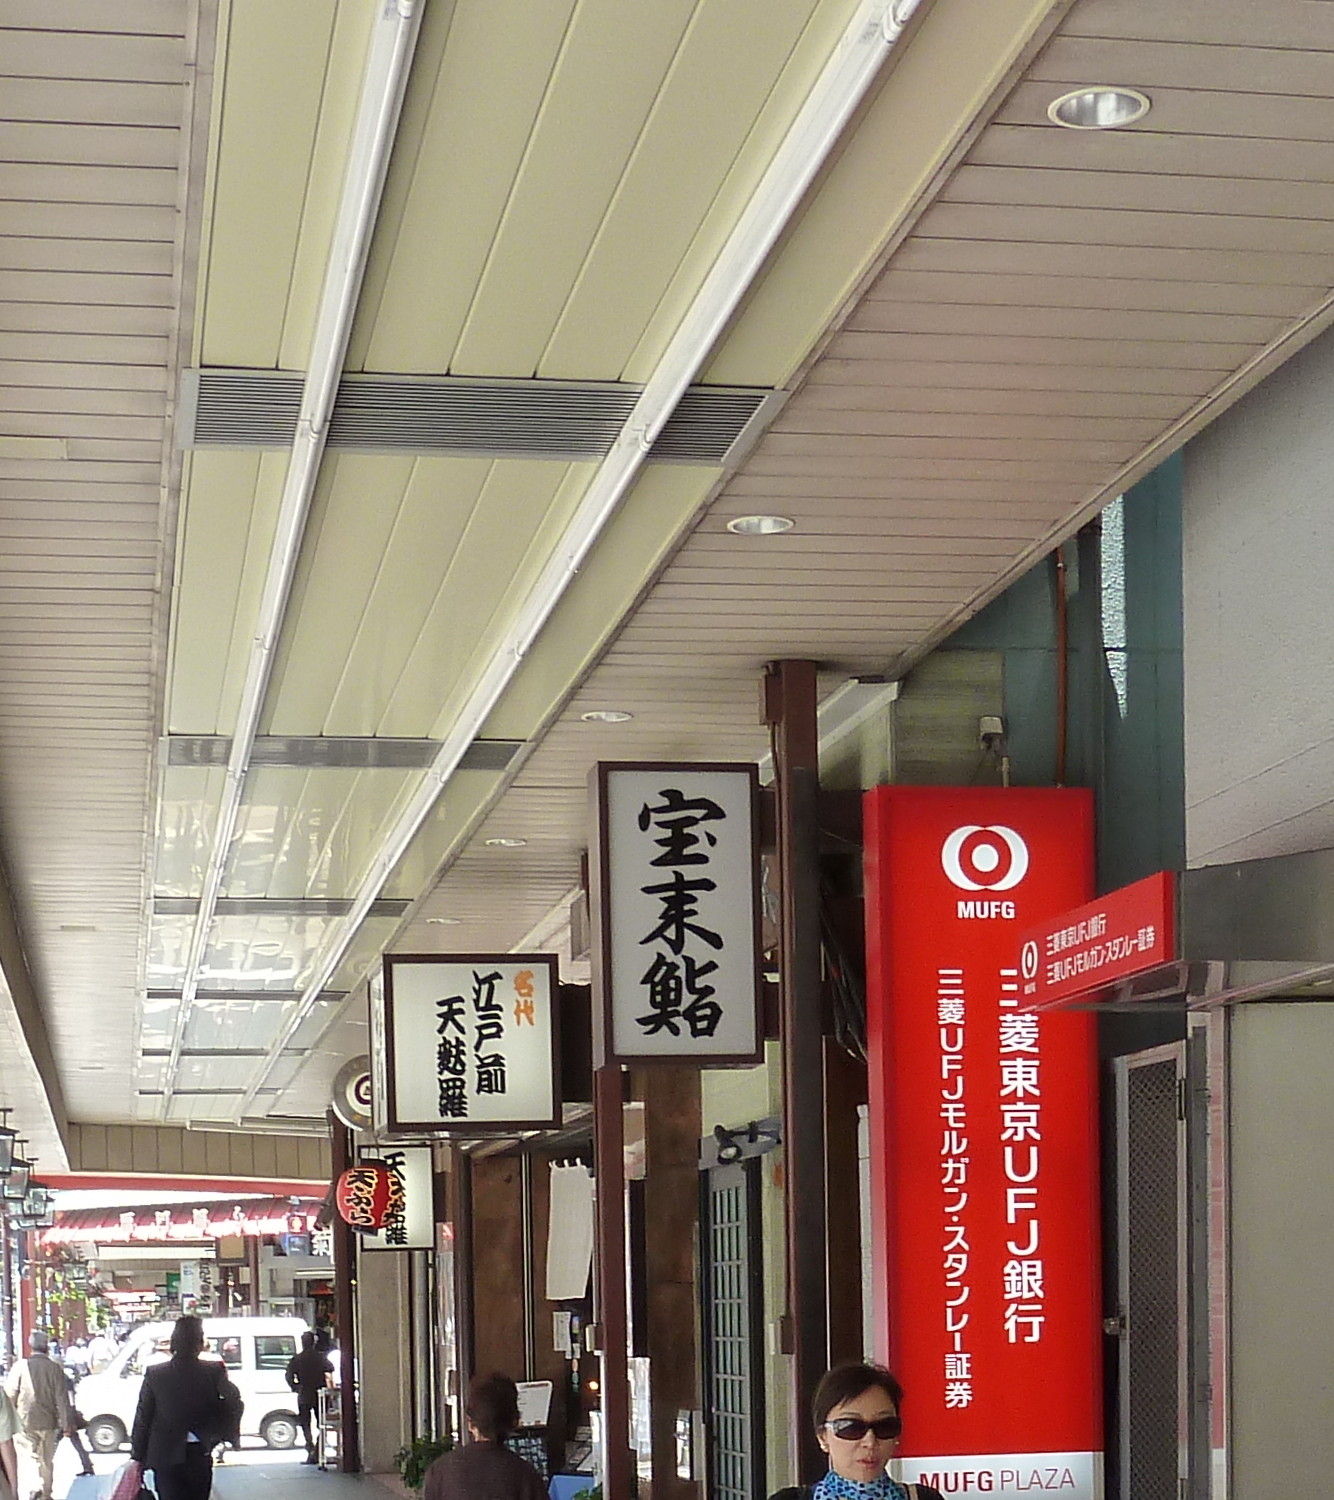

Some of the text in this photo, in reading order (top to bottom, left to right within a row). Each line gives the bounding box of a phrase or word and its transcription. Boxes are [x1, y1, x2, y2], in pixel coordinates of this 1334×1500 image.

[957, 901, 1015, 919] MUFG
[1046, 913, 1106, 956] 三菱東京UFJ銀行
[513, 969, 535, 1026] 名代
[472, 970, 506, 1095] 江戸前
[345, 1167, 378, 1226] 天ぷら
[937, 968, 973, 1409] 三菱UFJモルガン・スタンレー証券
[919, 1467, 1076, 1493] MUFG PLAZA
